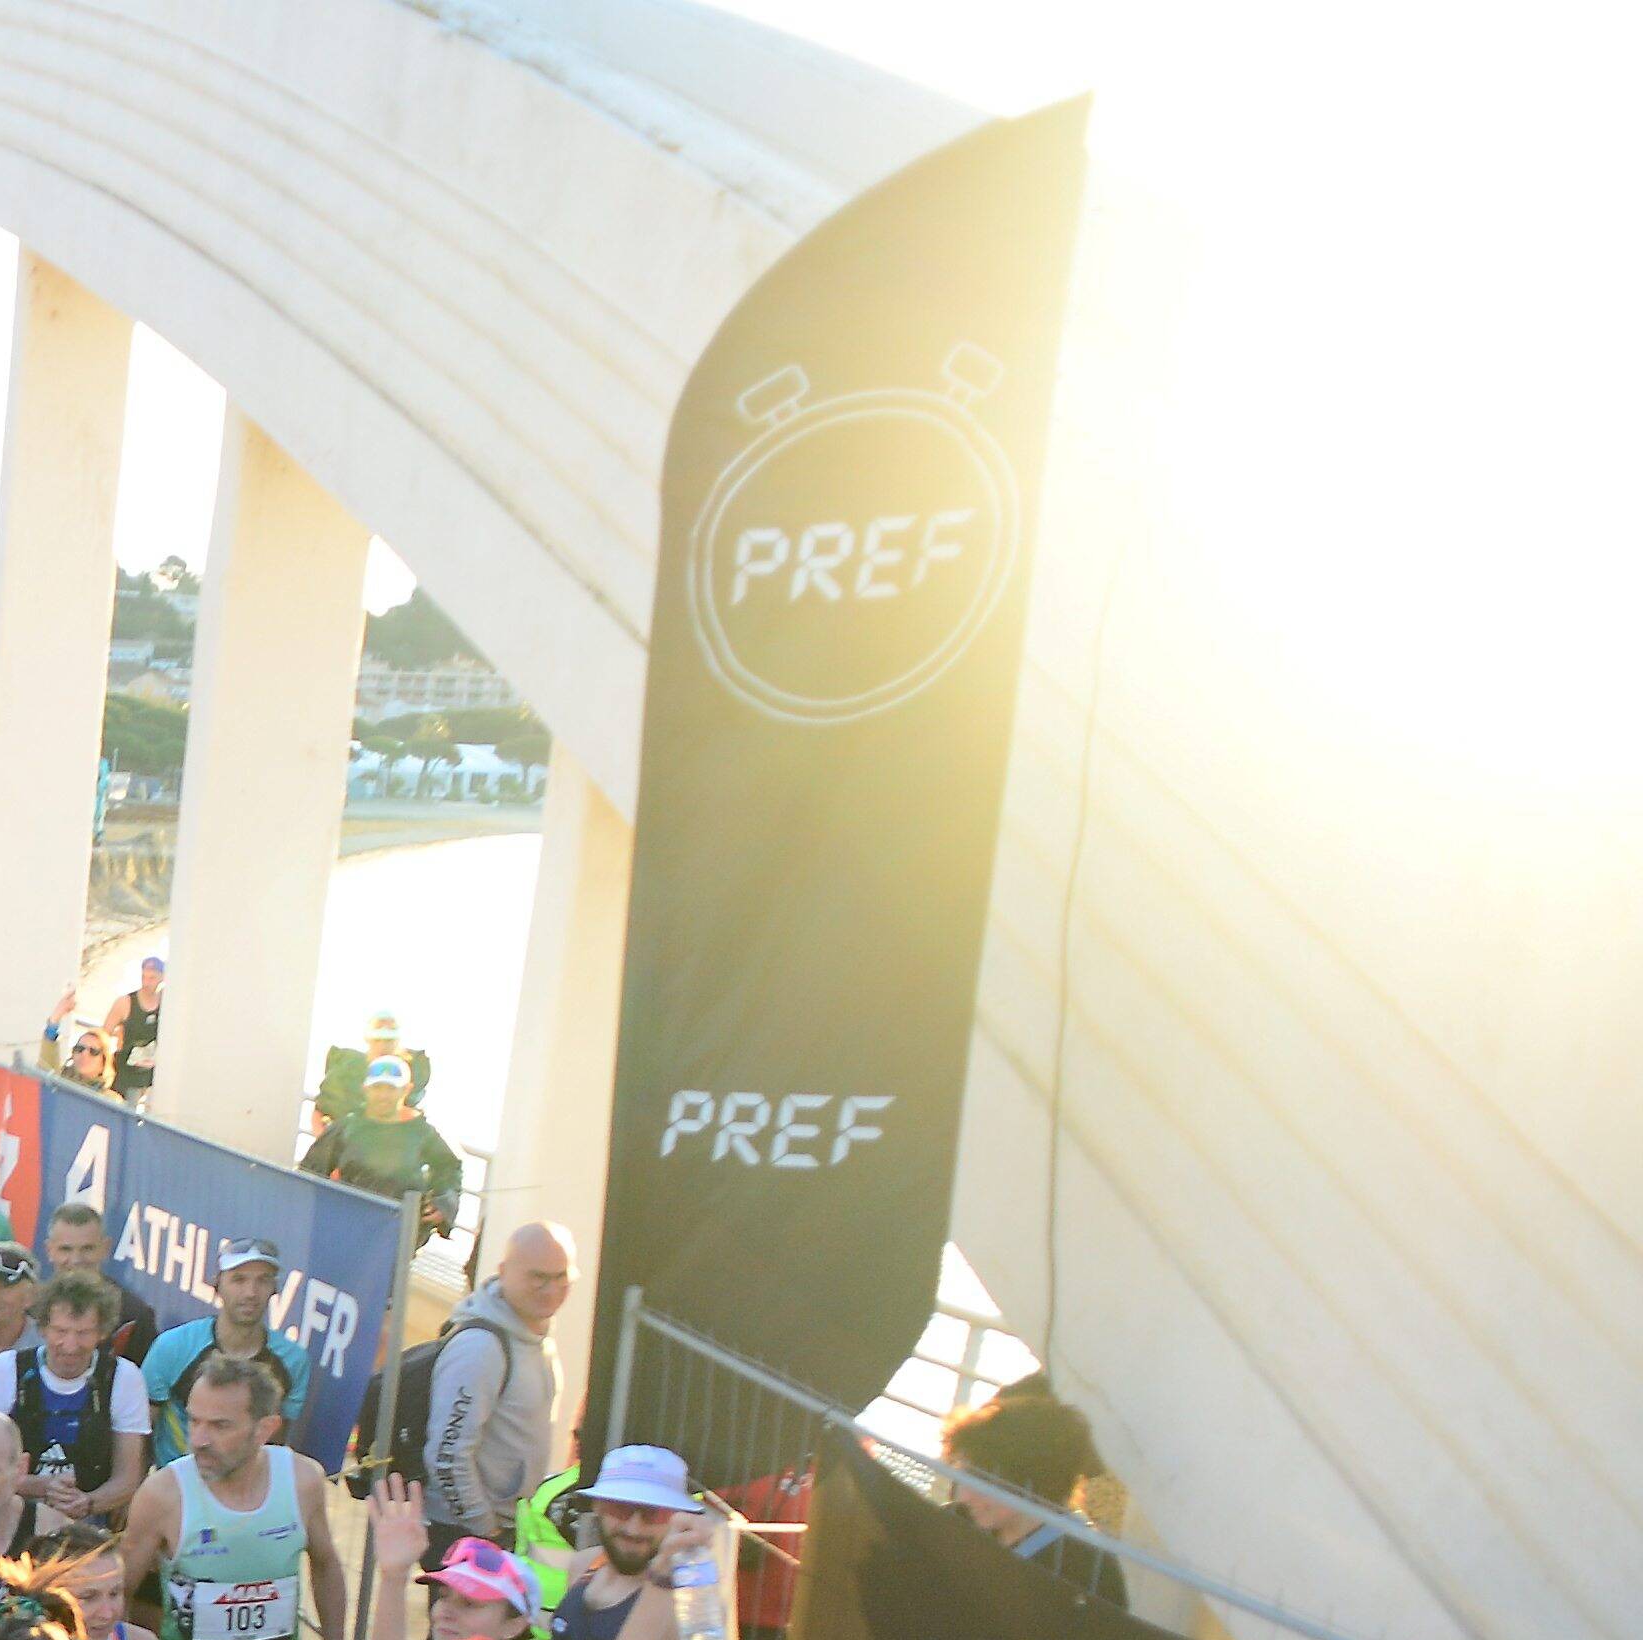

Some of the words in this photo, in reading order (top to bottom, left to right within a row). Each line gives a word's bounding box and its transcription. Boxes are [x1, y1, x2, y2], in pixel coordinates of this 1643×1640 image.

[731, 507, 977, 606] PREF
[661, 1089, 897, 1168] PREF
[223, 1603, 267, 1632] 103
